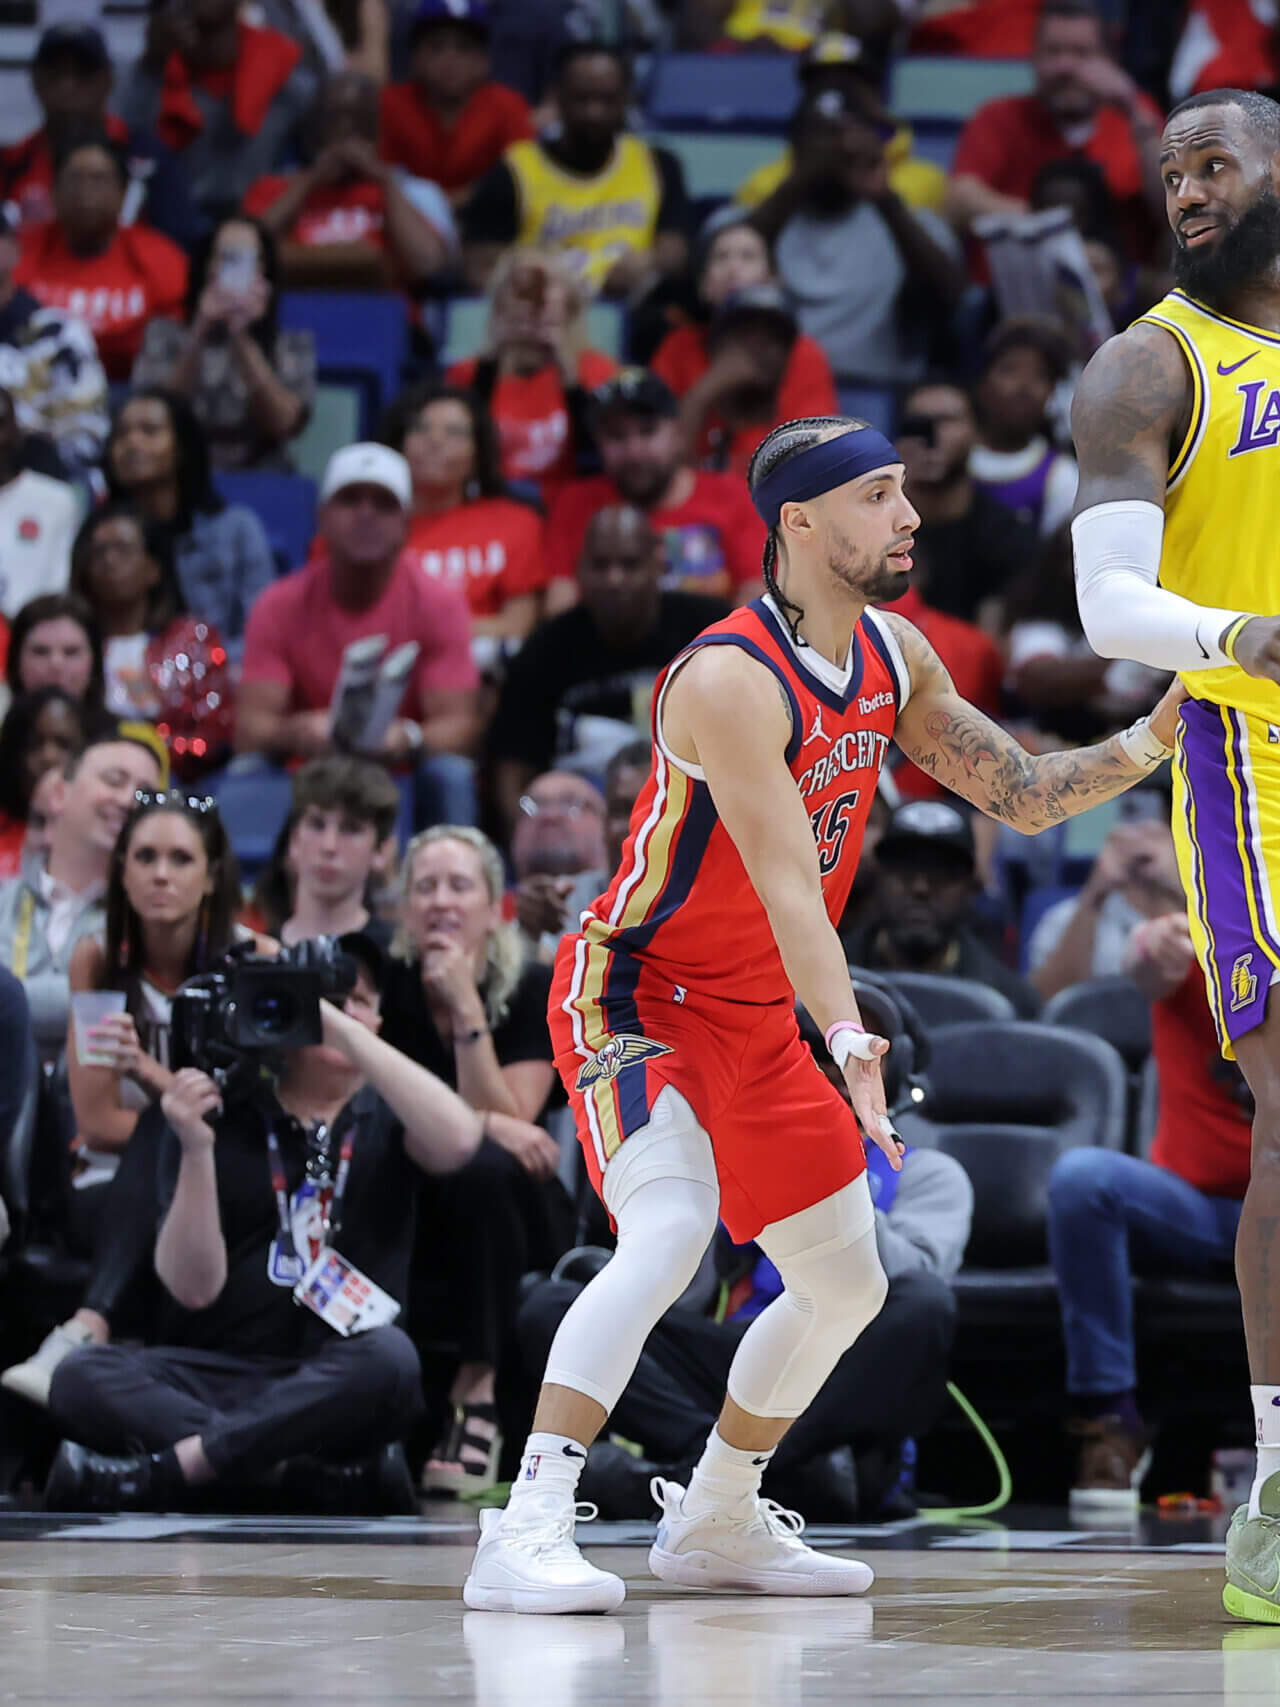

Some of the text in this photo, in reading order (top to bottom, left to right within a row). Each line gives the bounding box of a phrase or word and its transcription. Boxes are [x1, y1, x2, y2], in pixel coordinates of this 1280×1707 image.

[858, 691, 895, 715] ibotta
[798, 730, 890, 800] CRESCENT
[810, 789, 860, 876] 15
